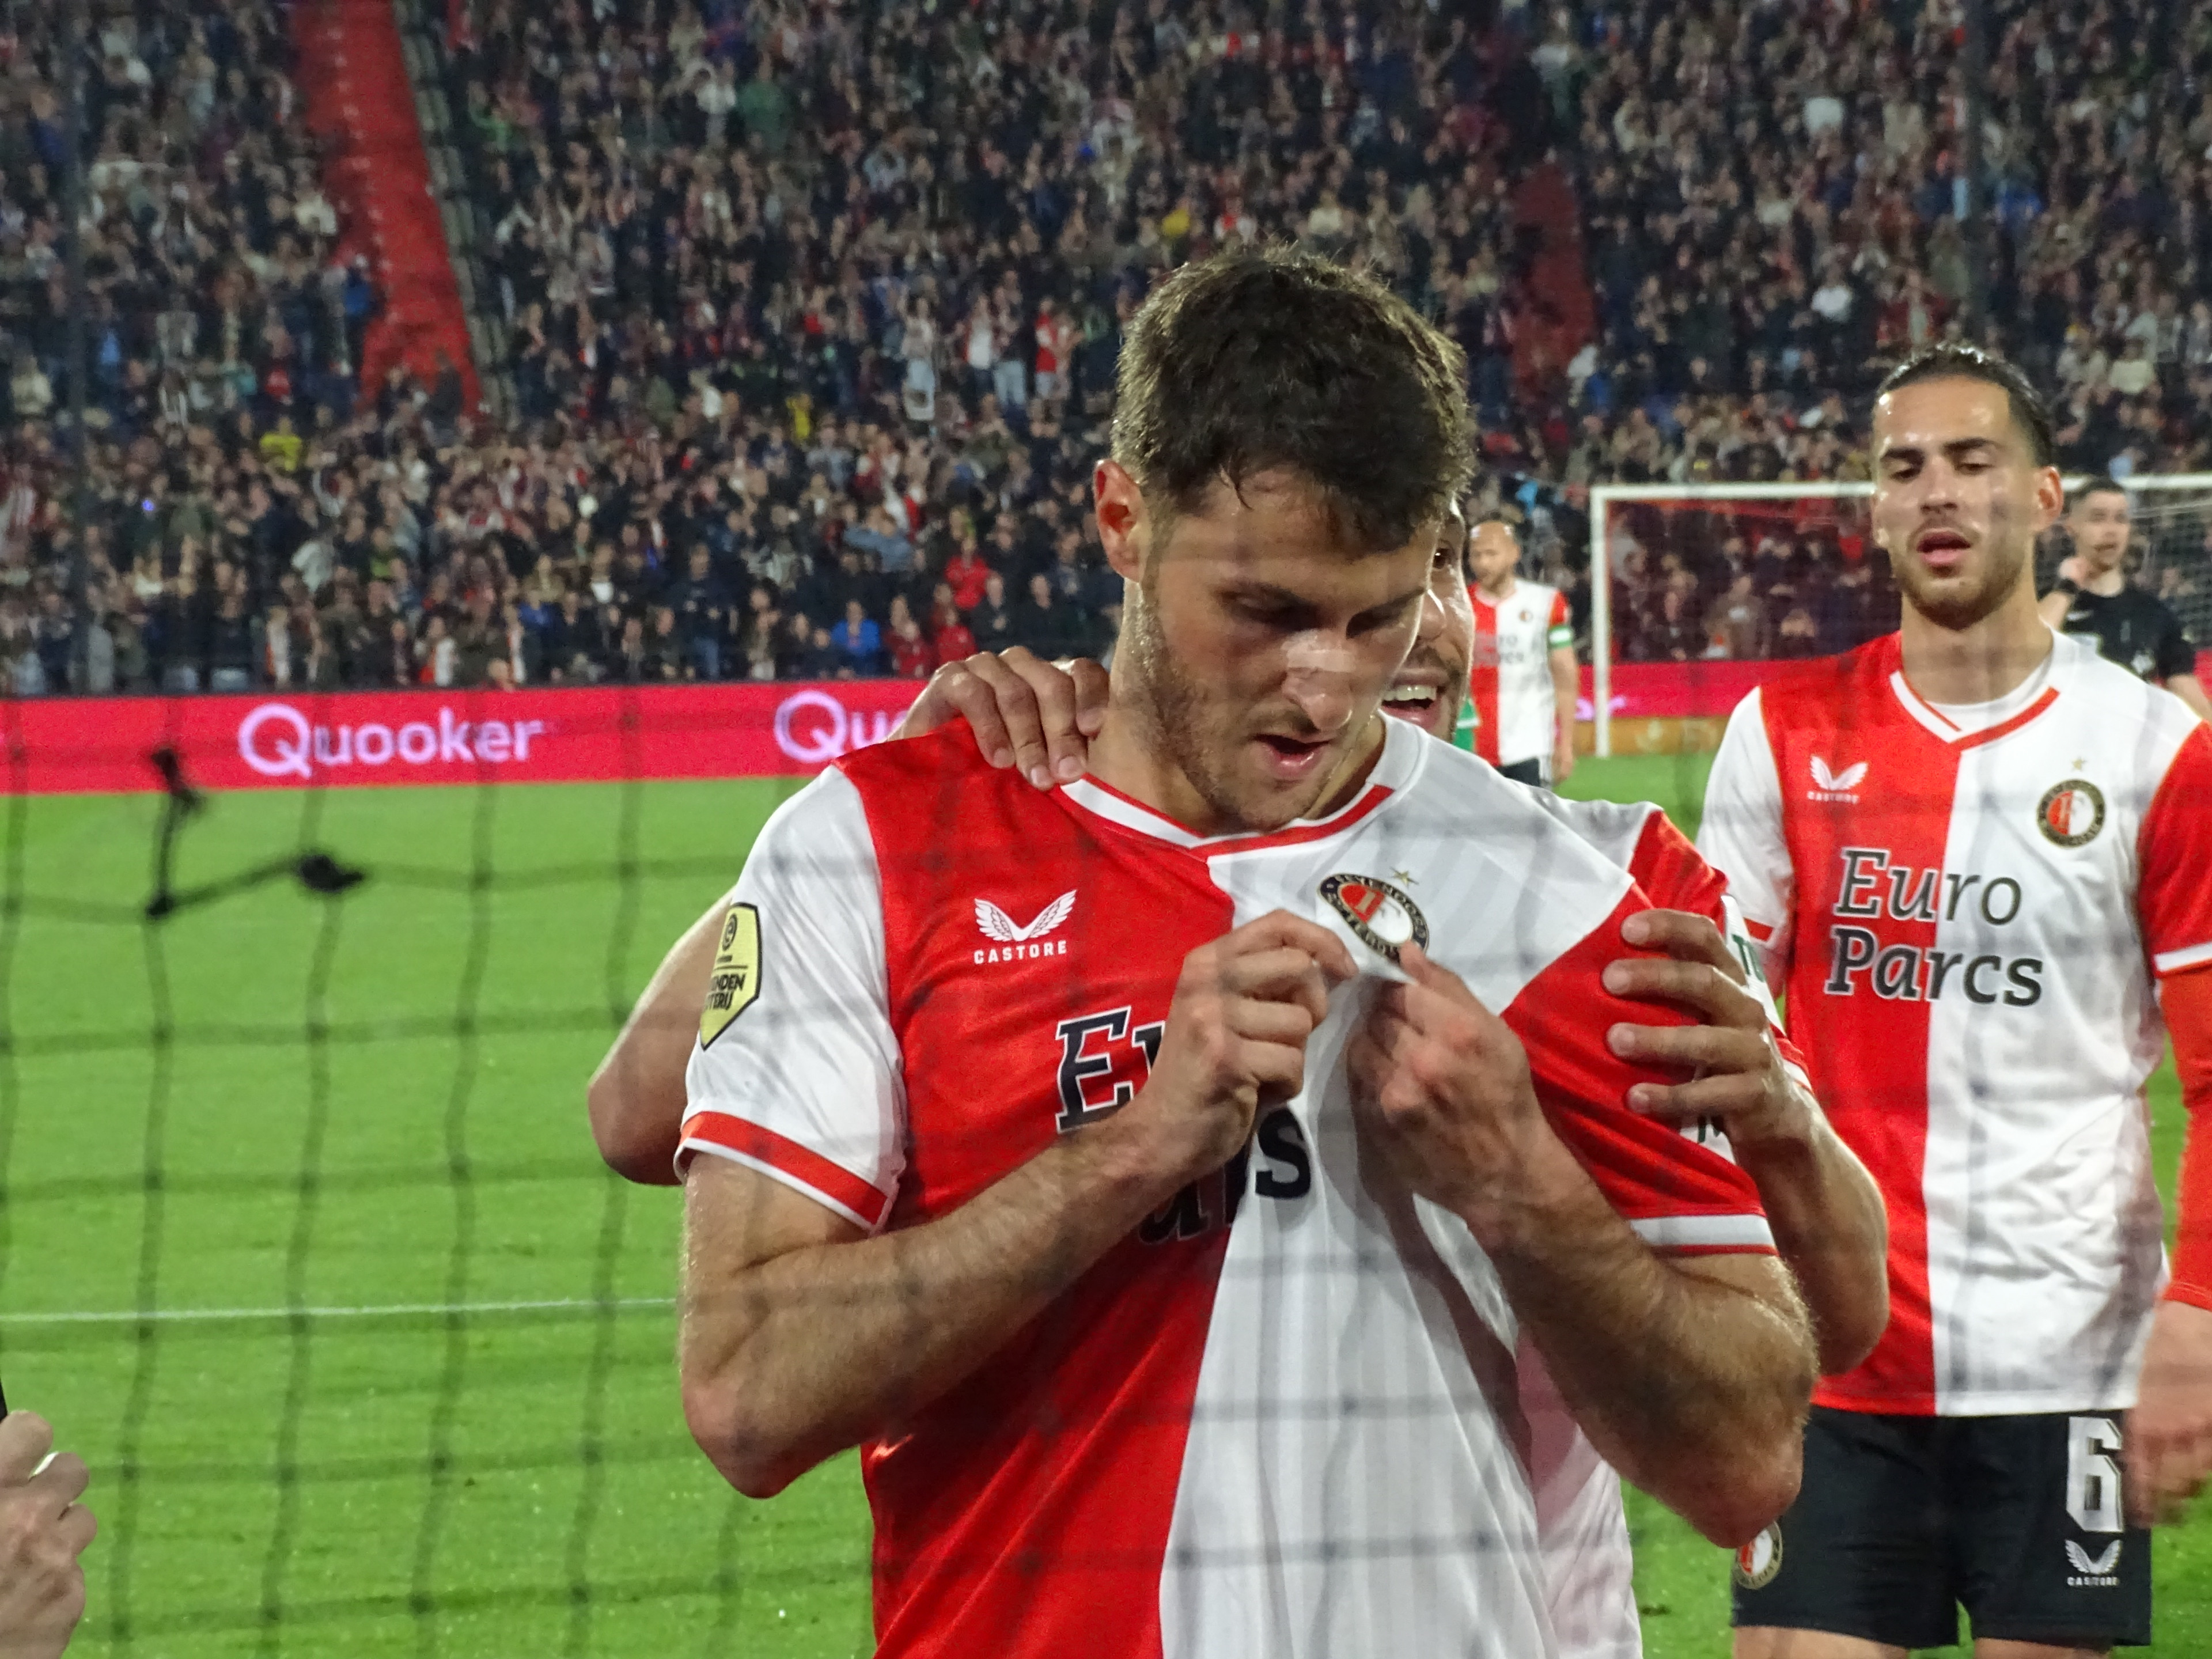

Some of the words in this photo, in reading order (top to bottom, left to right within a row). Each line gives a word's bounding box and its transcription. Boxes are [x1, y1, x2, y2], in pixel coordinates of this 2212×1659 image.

[238, 703, 543, 779] Quooker
[773, 690, 909, 764] Qu
[1832, 847, 2022, 926] Euro
[974, 940, 1068, 965] CASTORE
[1824, 924, 2044, 1007] Parcs
[2066, 1416, 2124, 1533] 6
